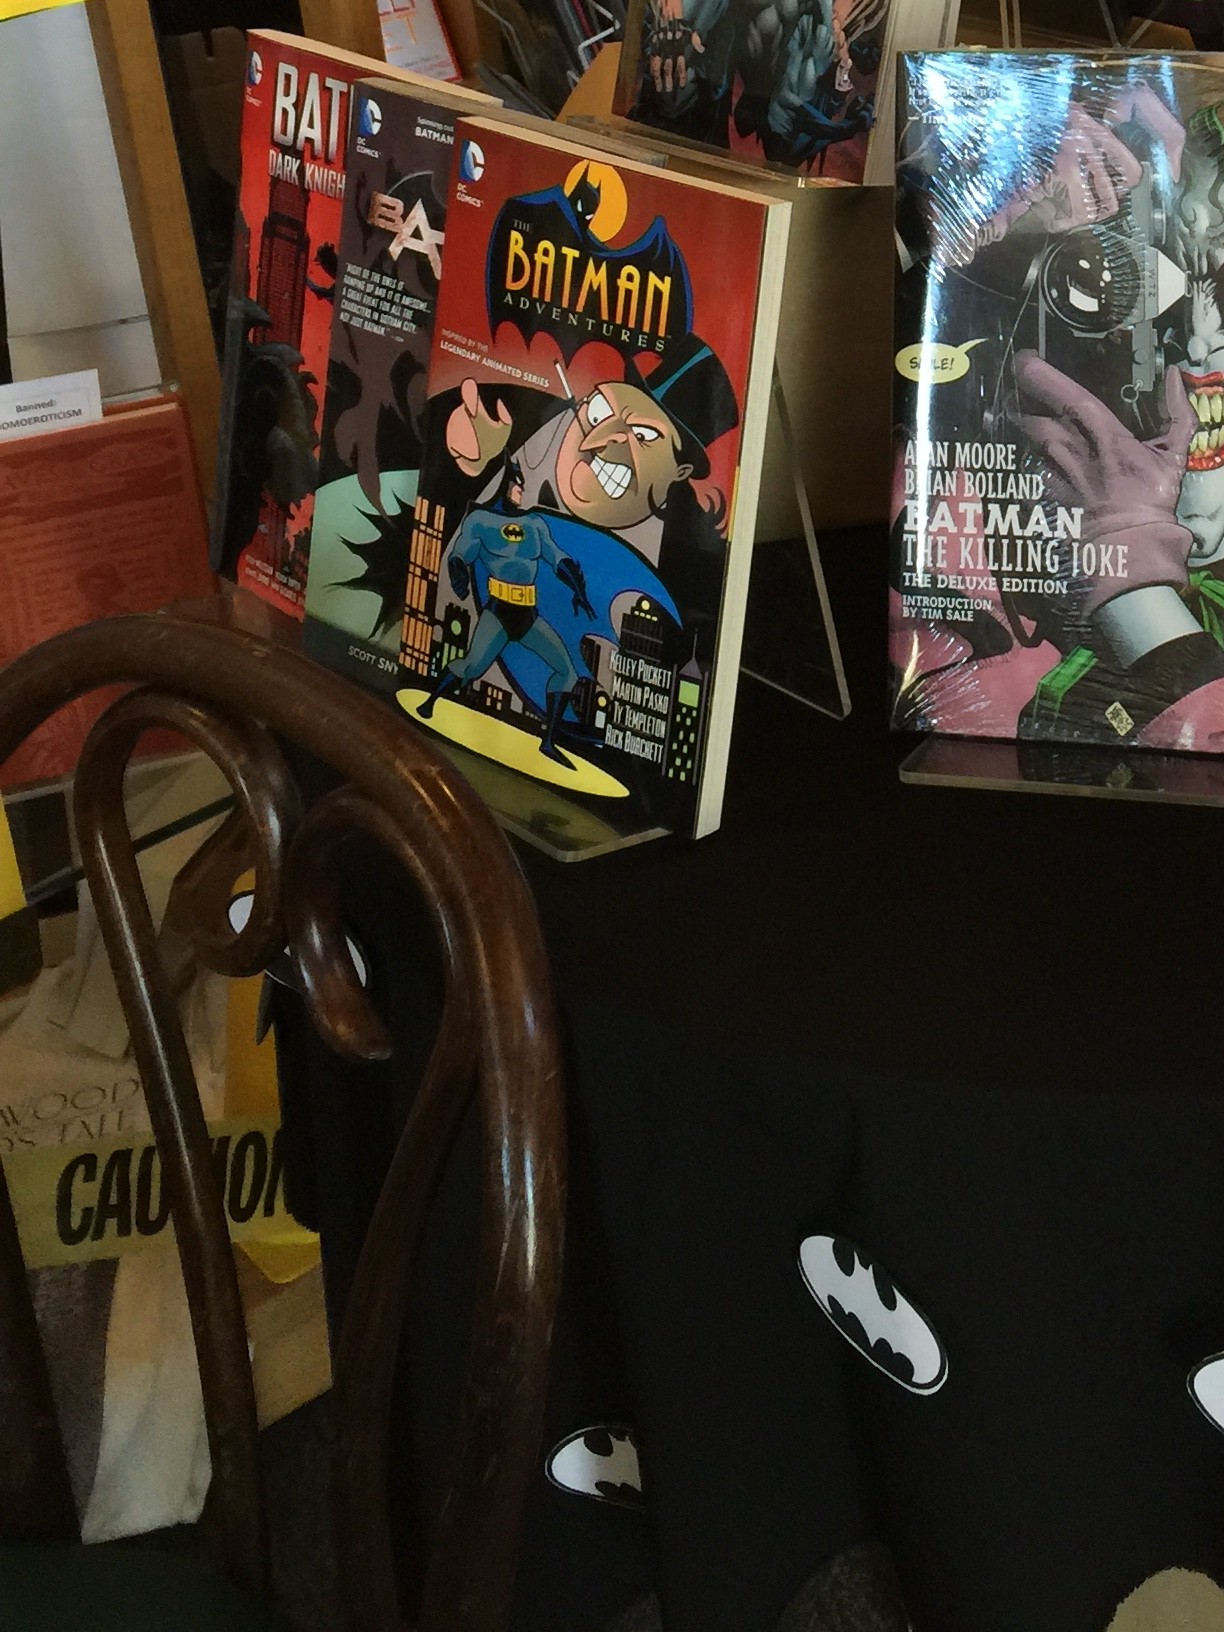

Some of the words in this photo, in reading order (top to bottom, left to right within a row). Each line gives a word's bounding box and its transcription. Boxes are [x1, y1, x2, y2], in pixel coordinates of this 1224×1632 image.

[356, 136, 367, 147] DC
[414, 125, 455, 146] BATMAN
[268, 148, 301, 181] DARK
[356, 143, 381, 159] COMICS
[456, 183, 468, 193] DC
[456, 191, 482, 208] COMICS
[513, 218, 534, 233] THE
[503, 229, 672, 338] BATMAN
[502, 291, 666, 353] ADVENTURES
[466, 335, 476, 348] BY
[440, 340, 481, 364] LEGENDARY
[481, 353, 522, 379] ANIMATED
[522, 369, 550, 388] SERIES
[954, 441, 1017, 471] MOORE
[963, 471, 1044, 501] BOLLAND
[958, 536, 1060, 575] KILLING
[1071, 541, 1130, 579] JOKE
[903, 571, 933, 589] THE
[936, 573, 998, 592] DELUXE
[1001, 575, 1068, 596] EDITION
[902, 594, 993, 612] INTRODUCTION
[902, 607, 919, 620] BY
[921, 608, 944, 621] TIM
[945, 608, 974, 622] SALE
[346, 644, 377, 664] SCOTT
[609, 649, 638, 676] KELLEY
[638, 658, 673, 690] PUCKETT
[611, 676, 644, 706] MARTIN
[643, 686, 670, 714] PASKO
[612, 703, 625, 726] TY
[625, 707, 666, 739] TEMPLETON
[604, 726, 624, 747] RICK
[623, 731, 664, 764] BURCHETT
